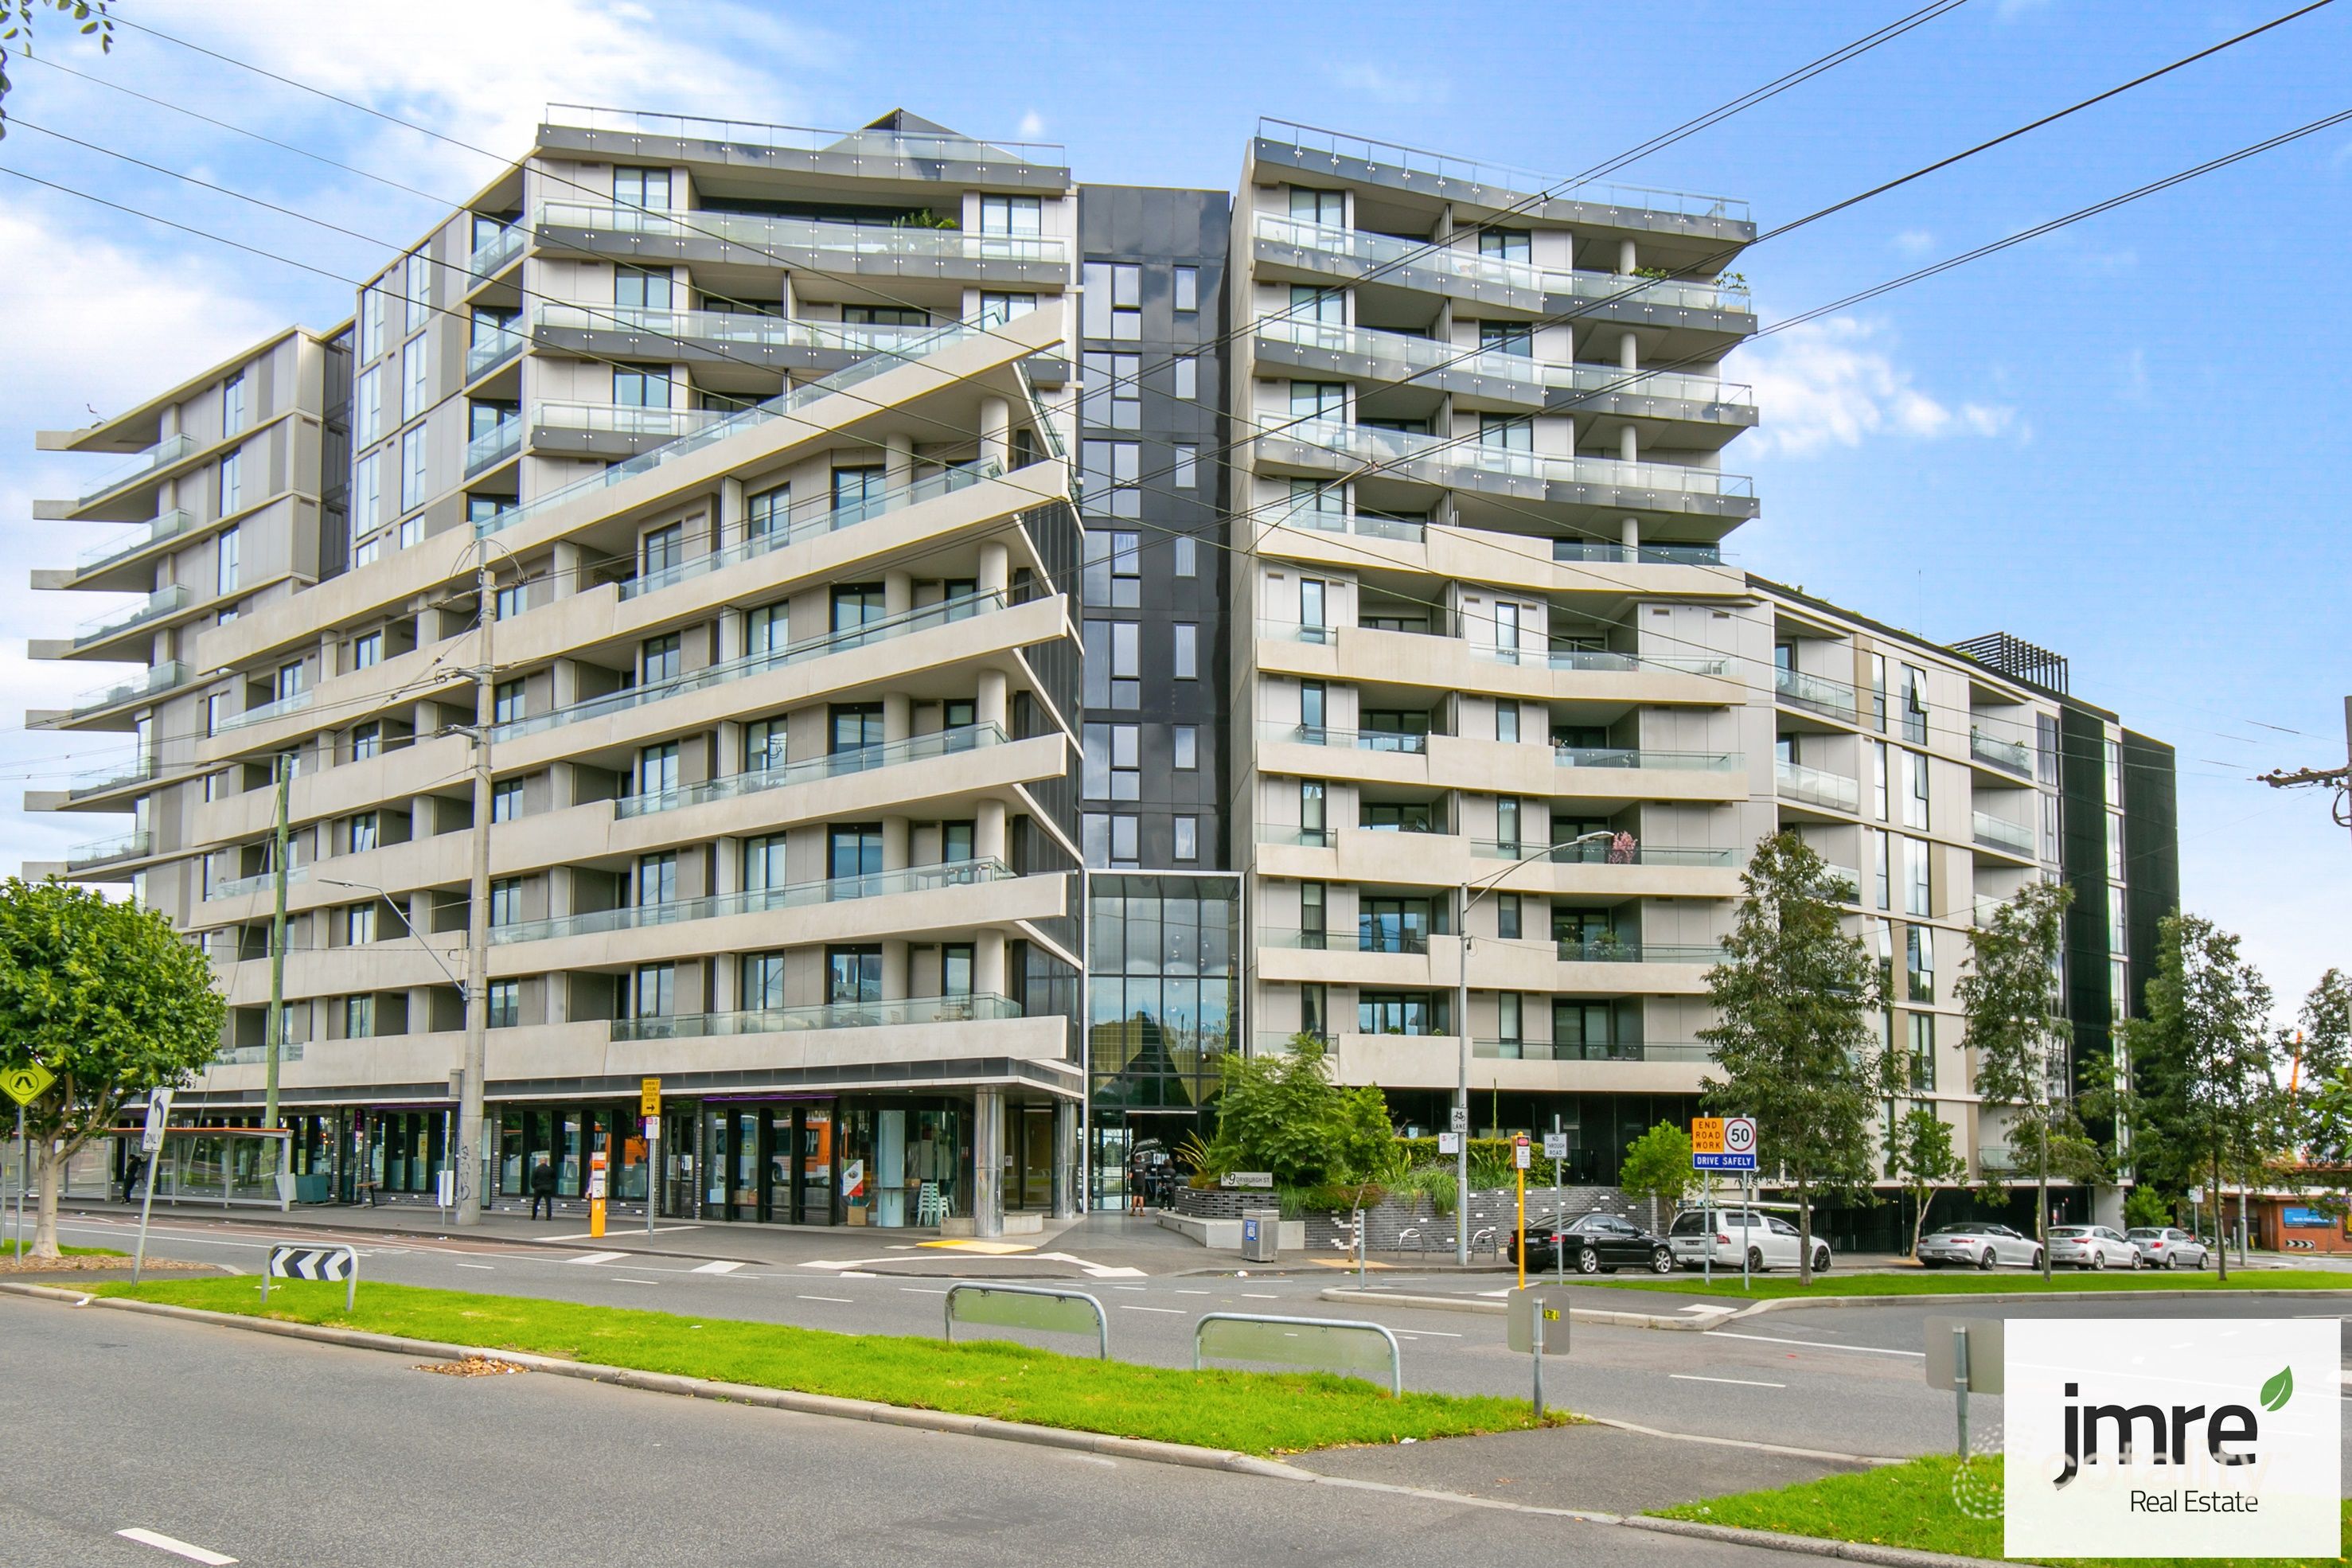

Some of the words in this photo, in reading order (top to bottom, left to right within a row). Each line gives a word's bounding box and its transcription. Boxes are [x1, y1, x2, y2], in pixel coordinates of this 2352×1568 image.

[1699, 1121, 1717, 1129] END
[145, 1133, 162, 1145] ONLY
[1731, 1128, 1749, 1143] 50
[1697, 1156, 1719, 1165] DRIVE
[1722, 1156, 1751, 1166] SAFELY
[1228, 1173, 1236, 1185] 9
